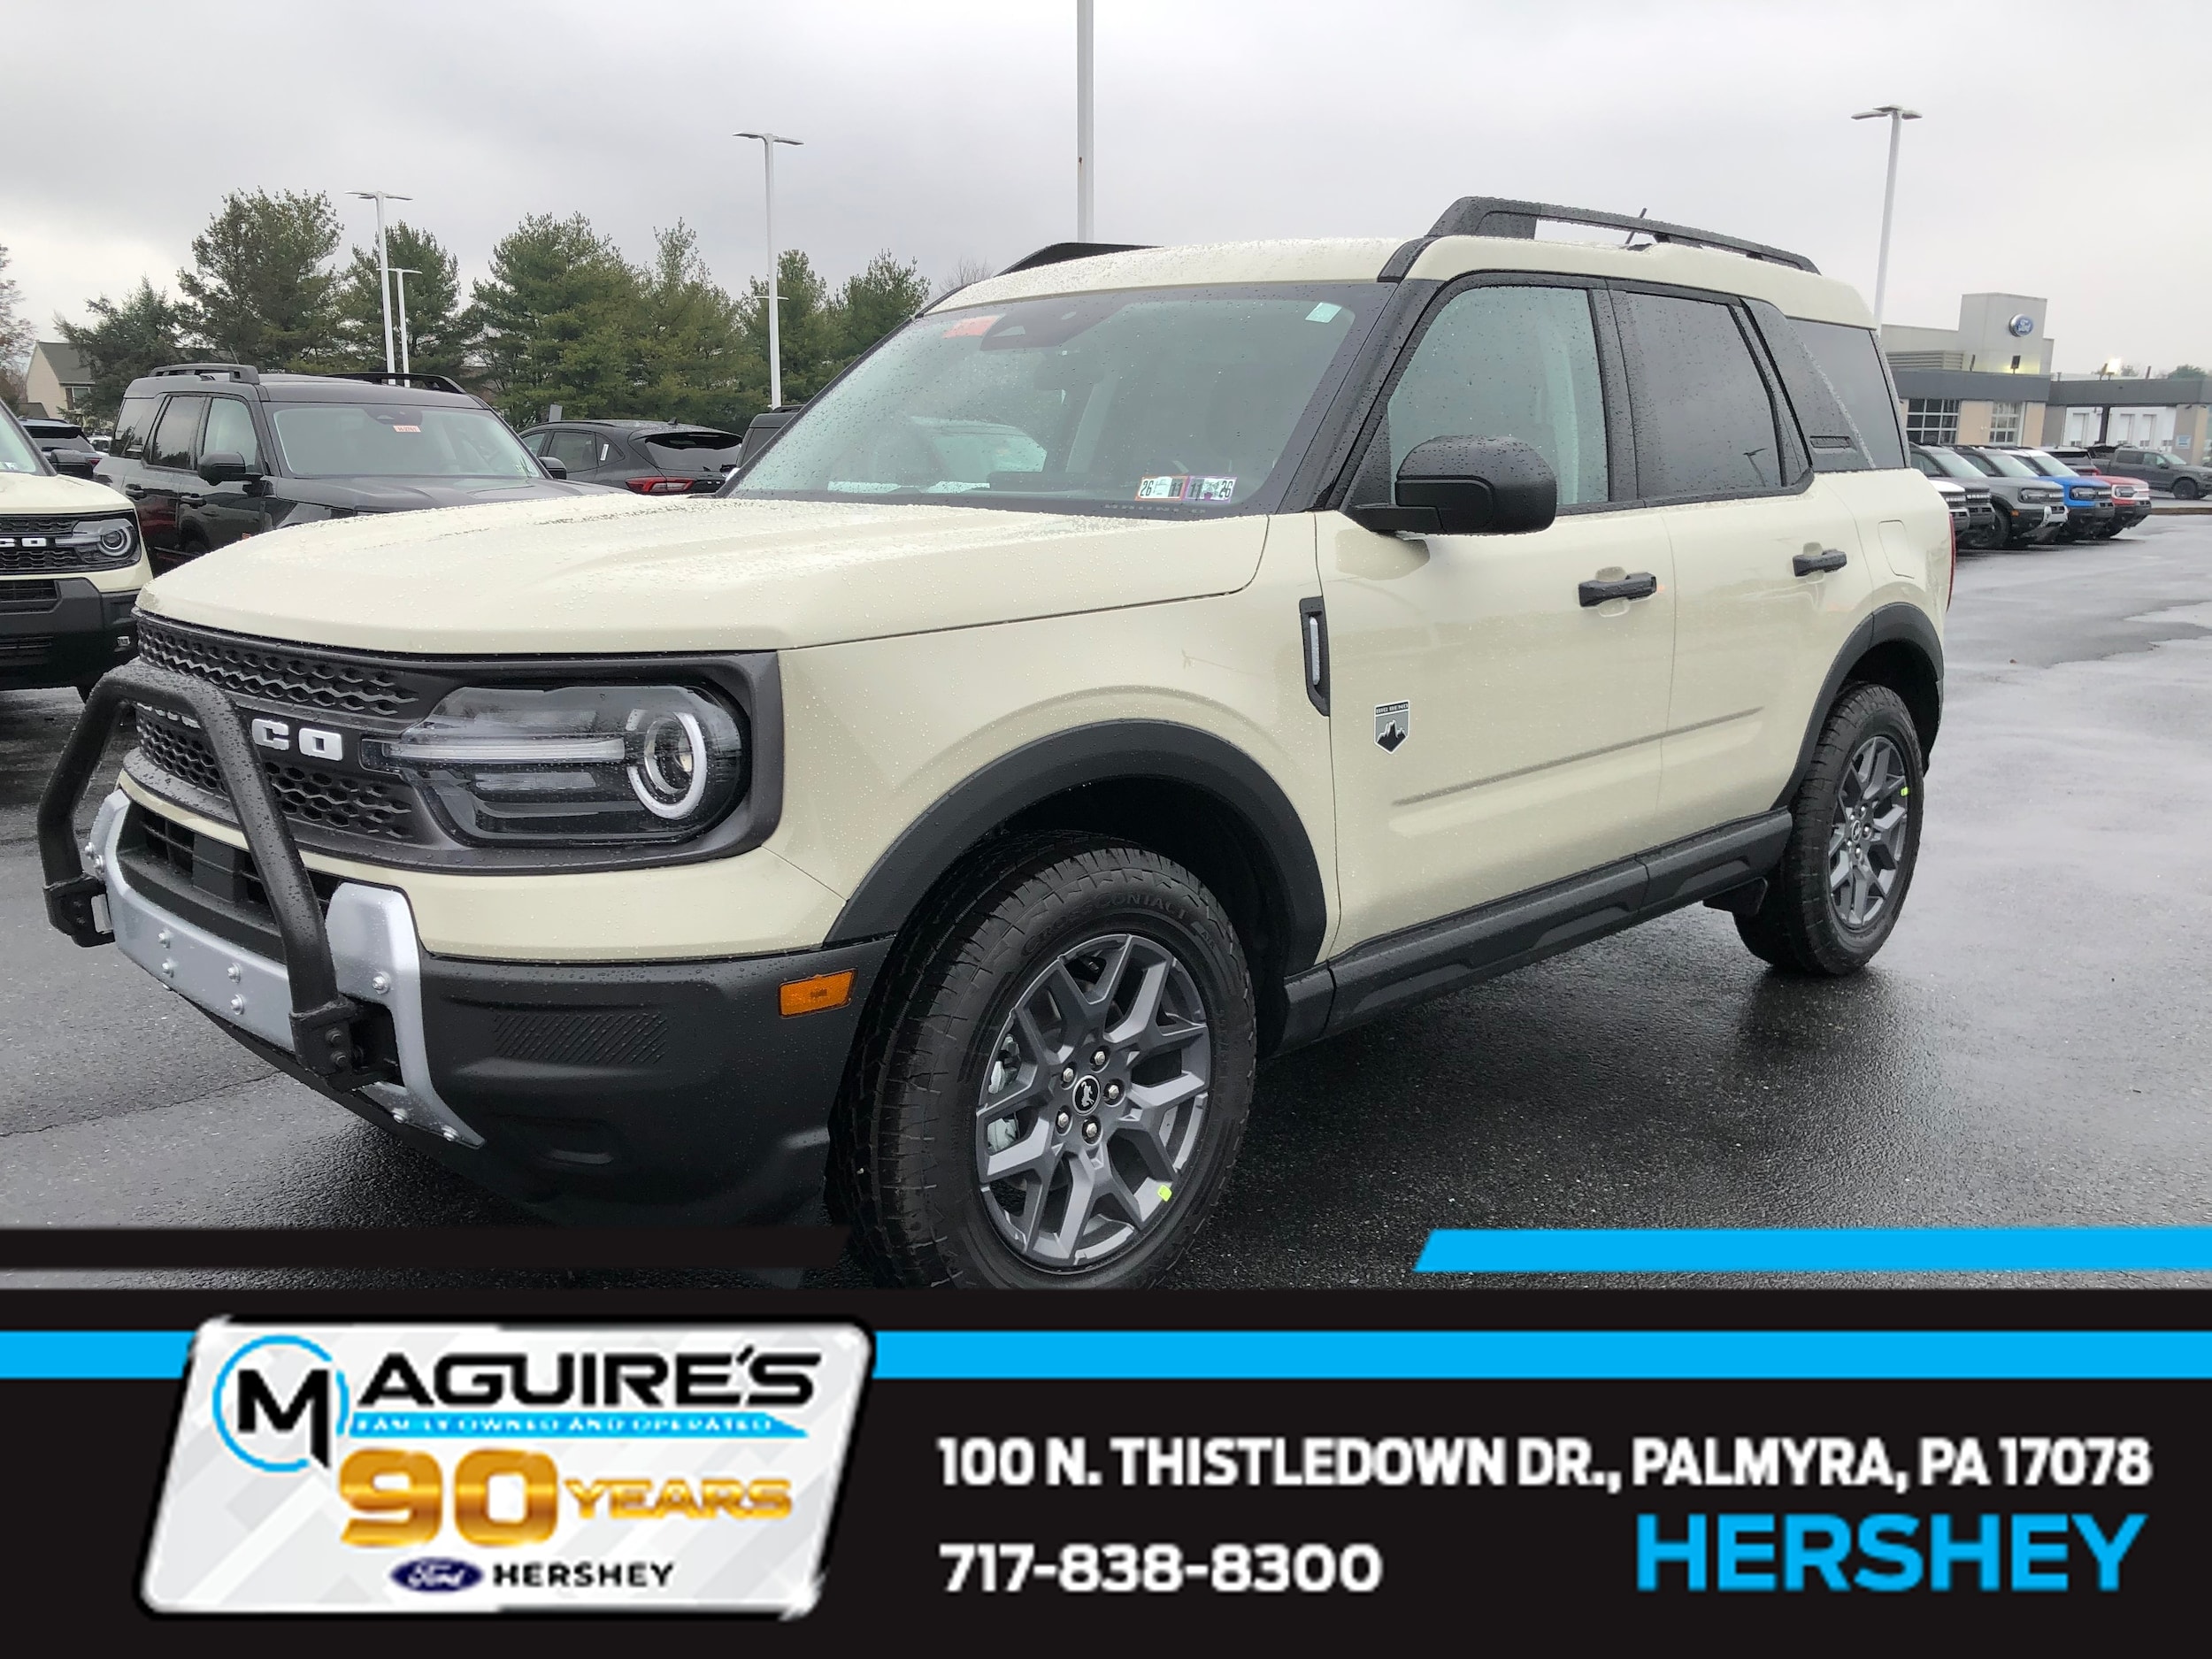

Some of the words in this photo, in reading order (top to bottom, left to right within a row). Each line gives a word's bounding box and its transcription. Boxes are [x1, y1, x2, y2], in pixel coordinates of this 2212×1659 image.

[1141, 480, 1154, 496] 26
[1169, 482, 1184, 497] 11
[1188, 483, 1202, 498] 11
[1218, 480, 1233, 498] 26
